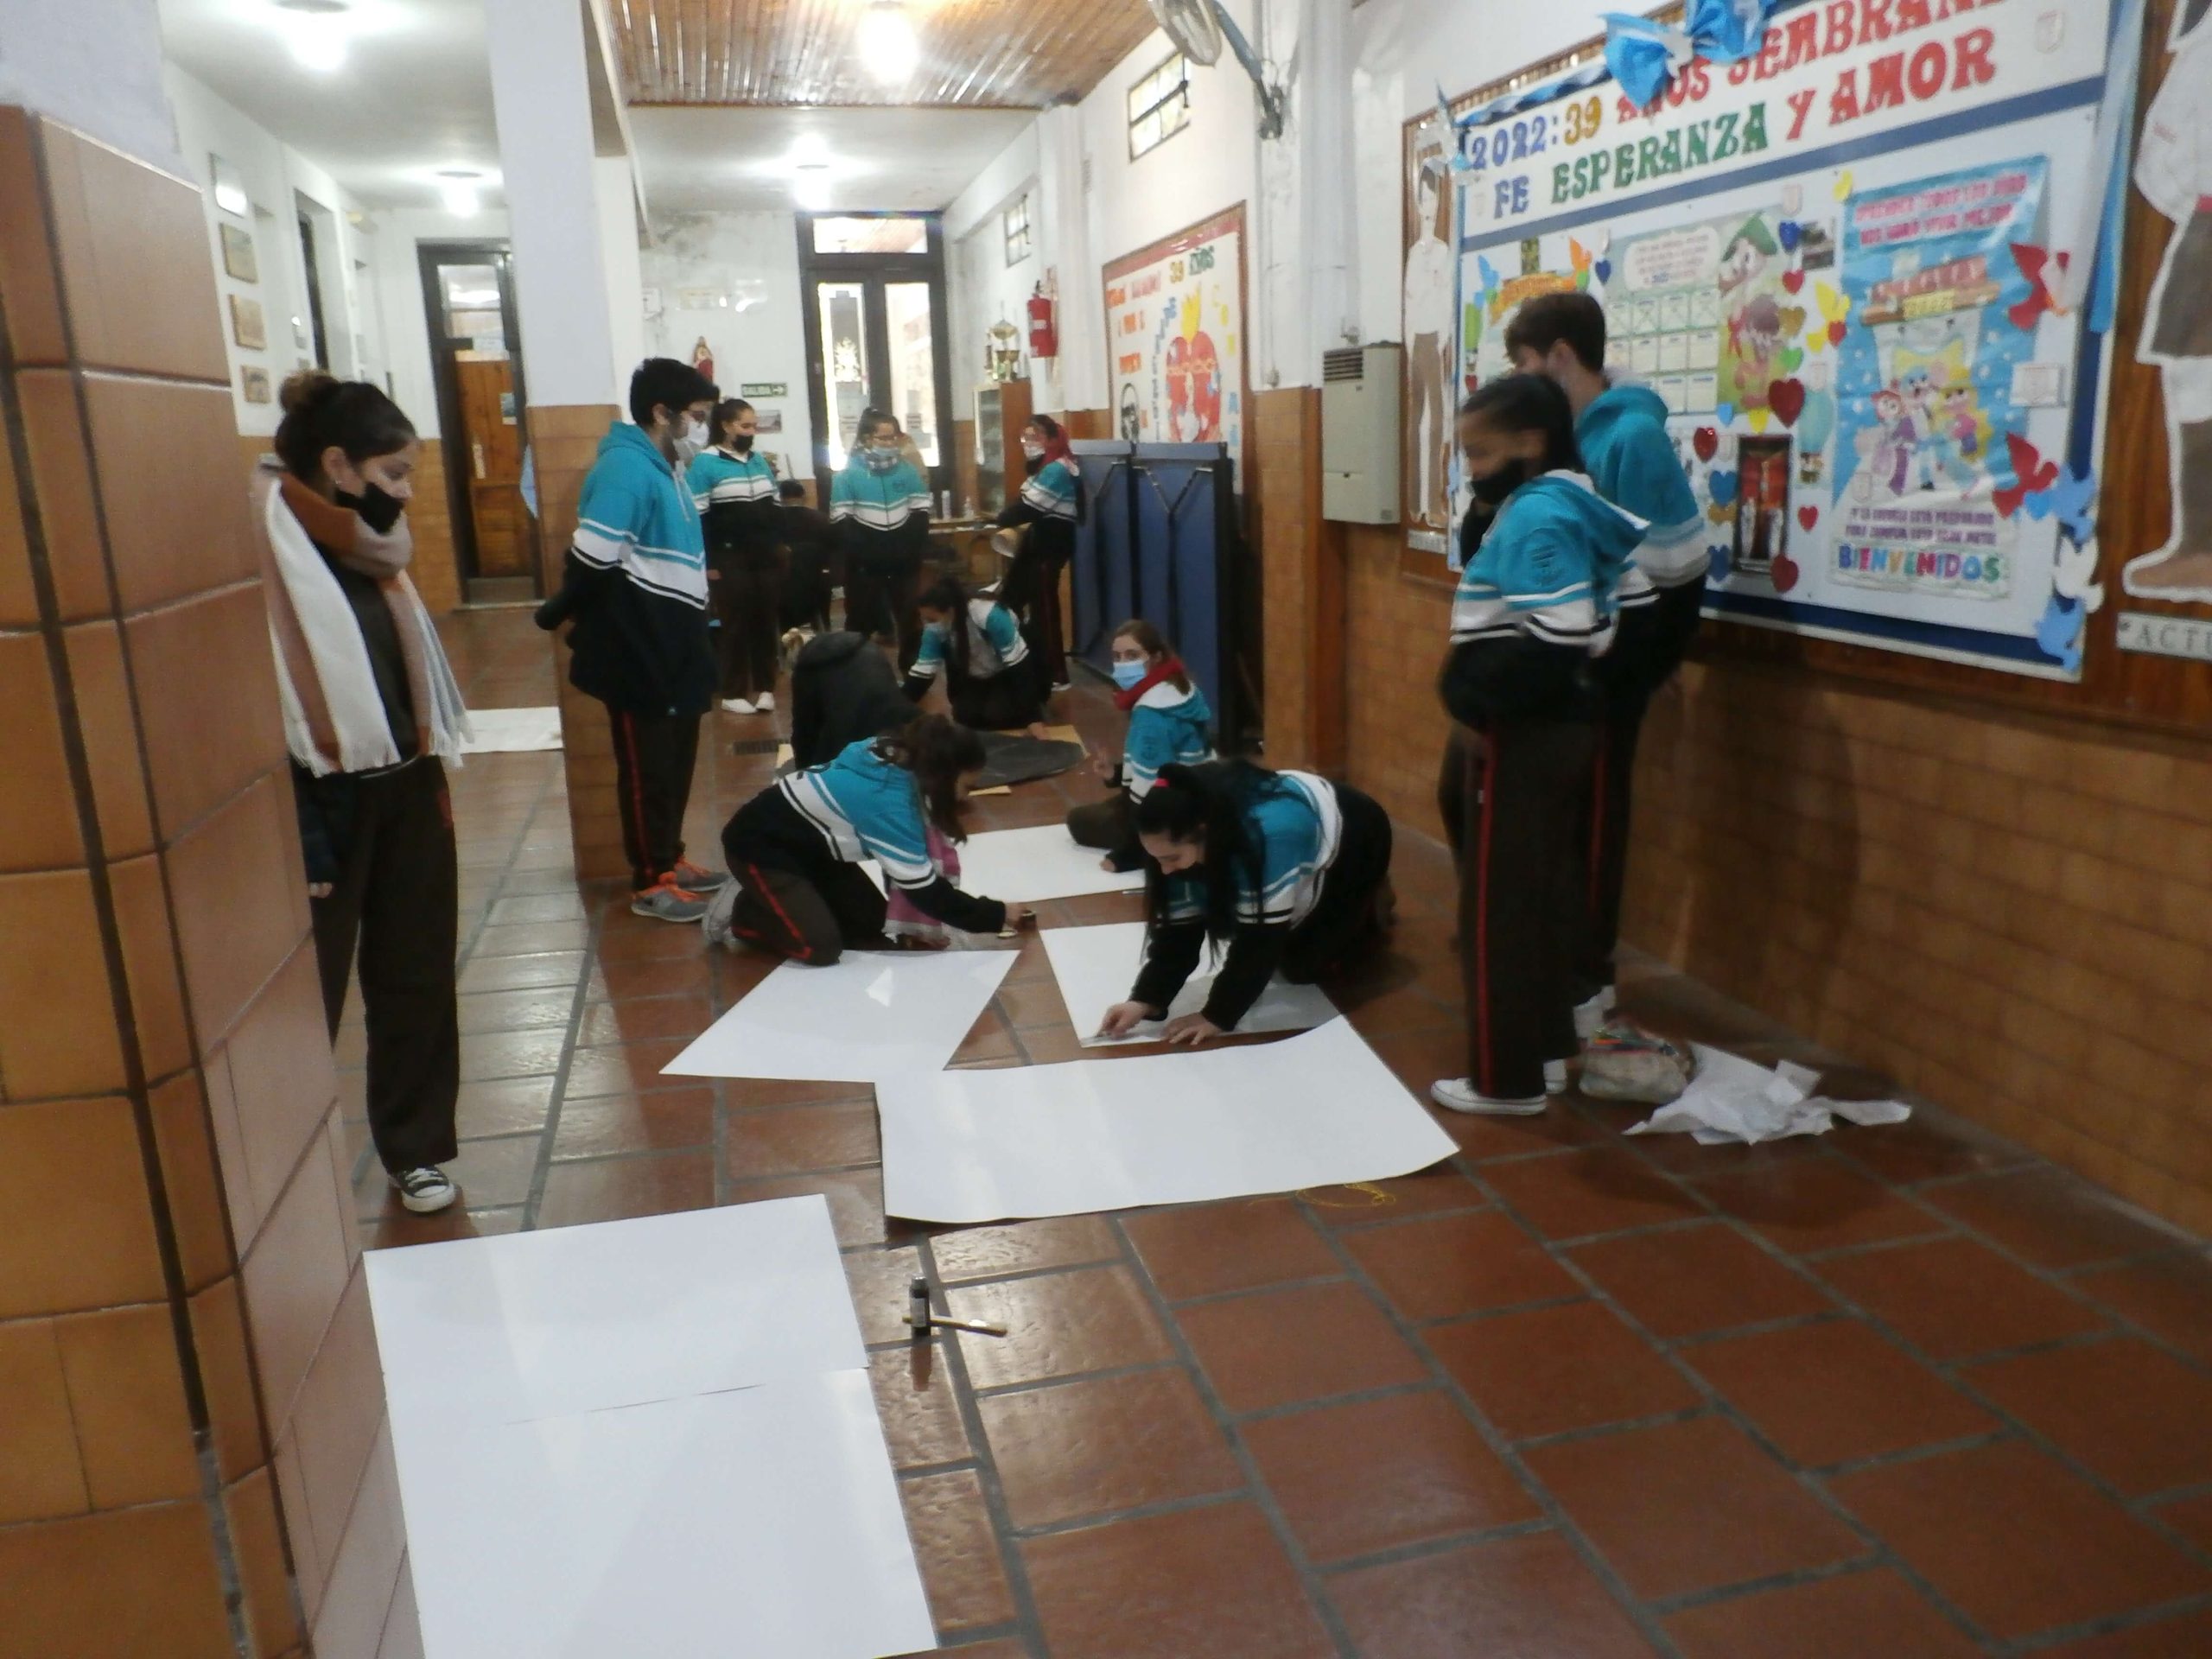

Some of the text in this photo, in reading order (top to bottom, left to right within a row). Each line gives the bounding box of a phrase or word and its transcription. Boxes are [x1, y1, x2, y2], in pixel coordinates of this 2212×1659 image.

[1494, 175, 1529, 218] FE
[1552, 101, 1769, 204] ESPERANZA
[1786, 89, 1816, 141] Y
[1828, 28, 1996, 126] AMOR
[1617, 54, 1710, 124] AOS
[1839, 544, 2000, 584] BIENVENIDOS
